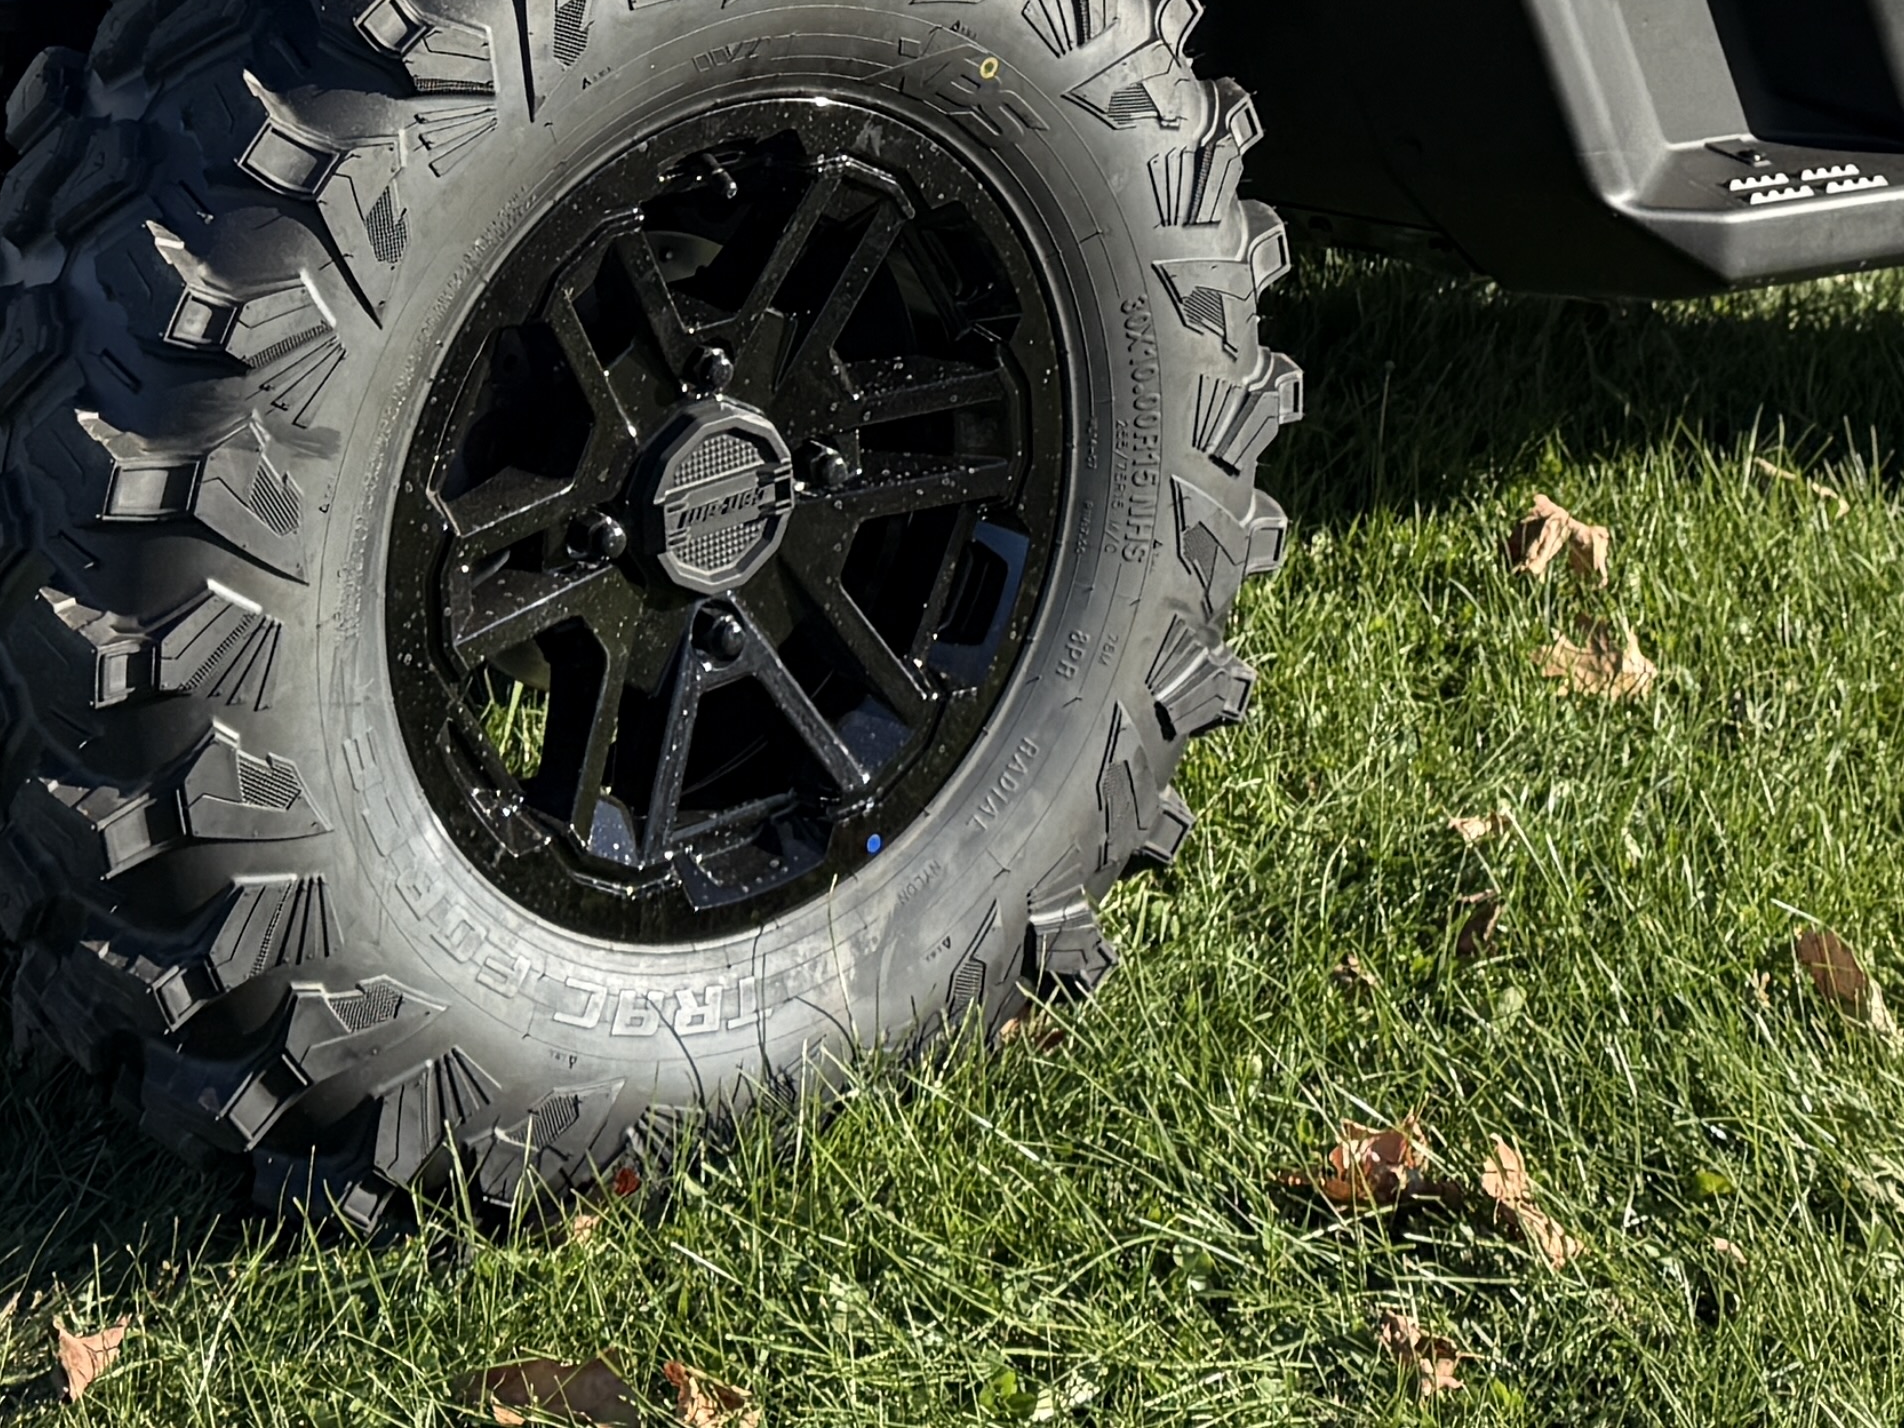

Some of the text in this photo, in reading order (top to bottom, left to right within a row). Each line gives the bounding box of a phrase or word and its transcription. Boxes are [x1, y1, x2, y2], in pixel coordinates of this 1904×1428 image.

[1120, 294, 1162, 562] 30X10.00R15 NHS
[1056, 630, 1091, 680] 8PR
[966, 737, 1040, 831] RADIAL
[898, 859, 942, 905] NYLON
[553, 976, 773, 1037] TRAC
